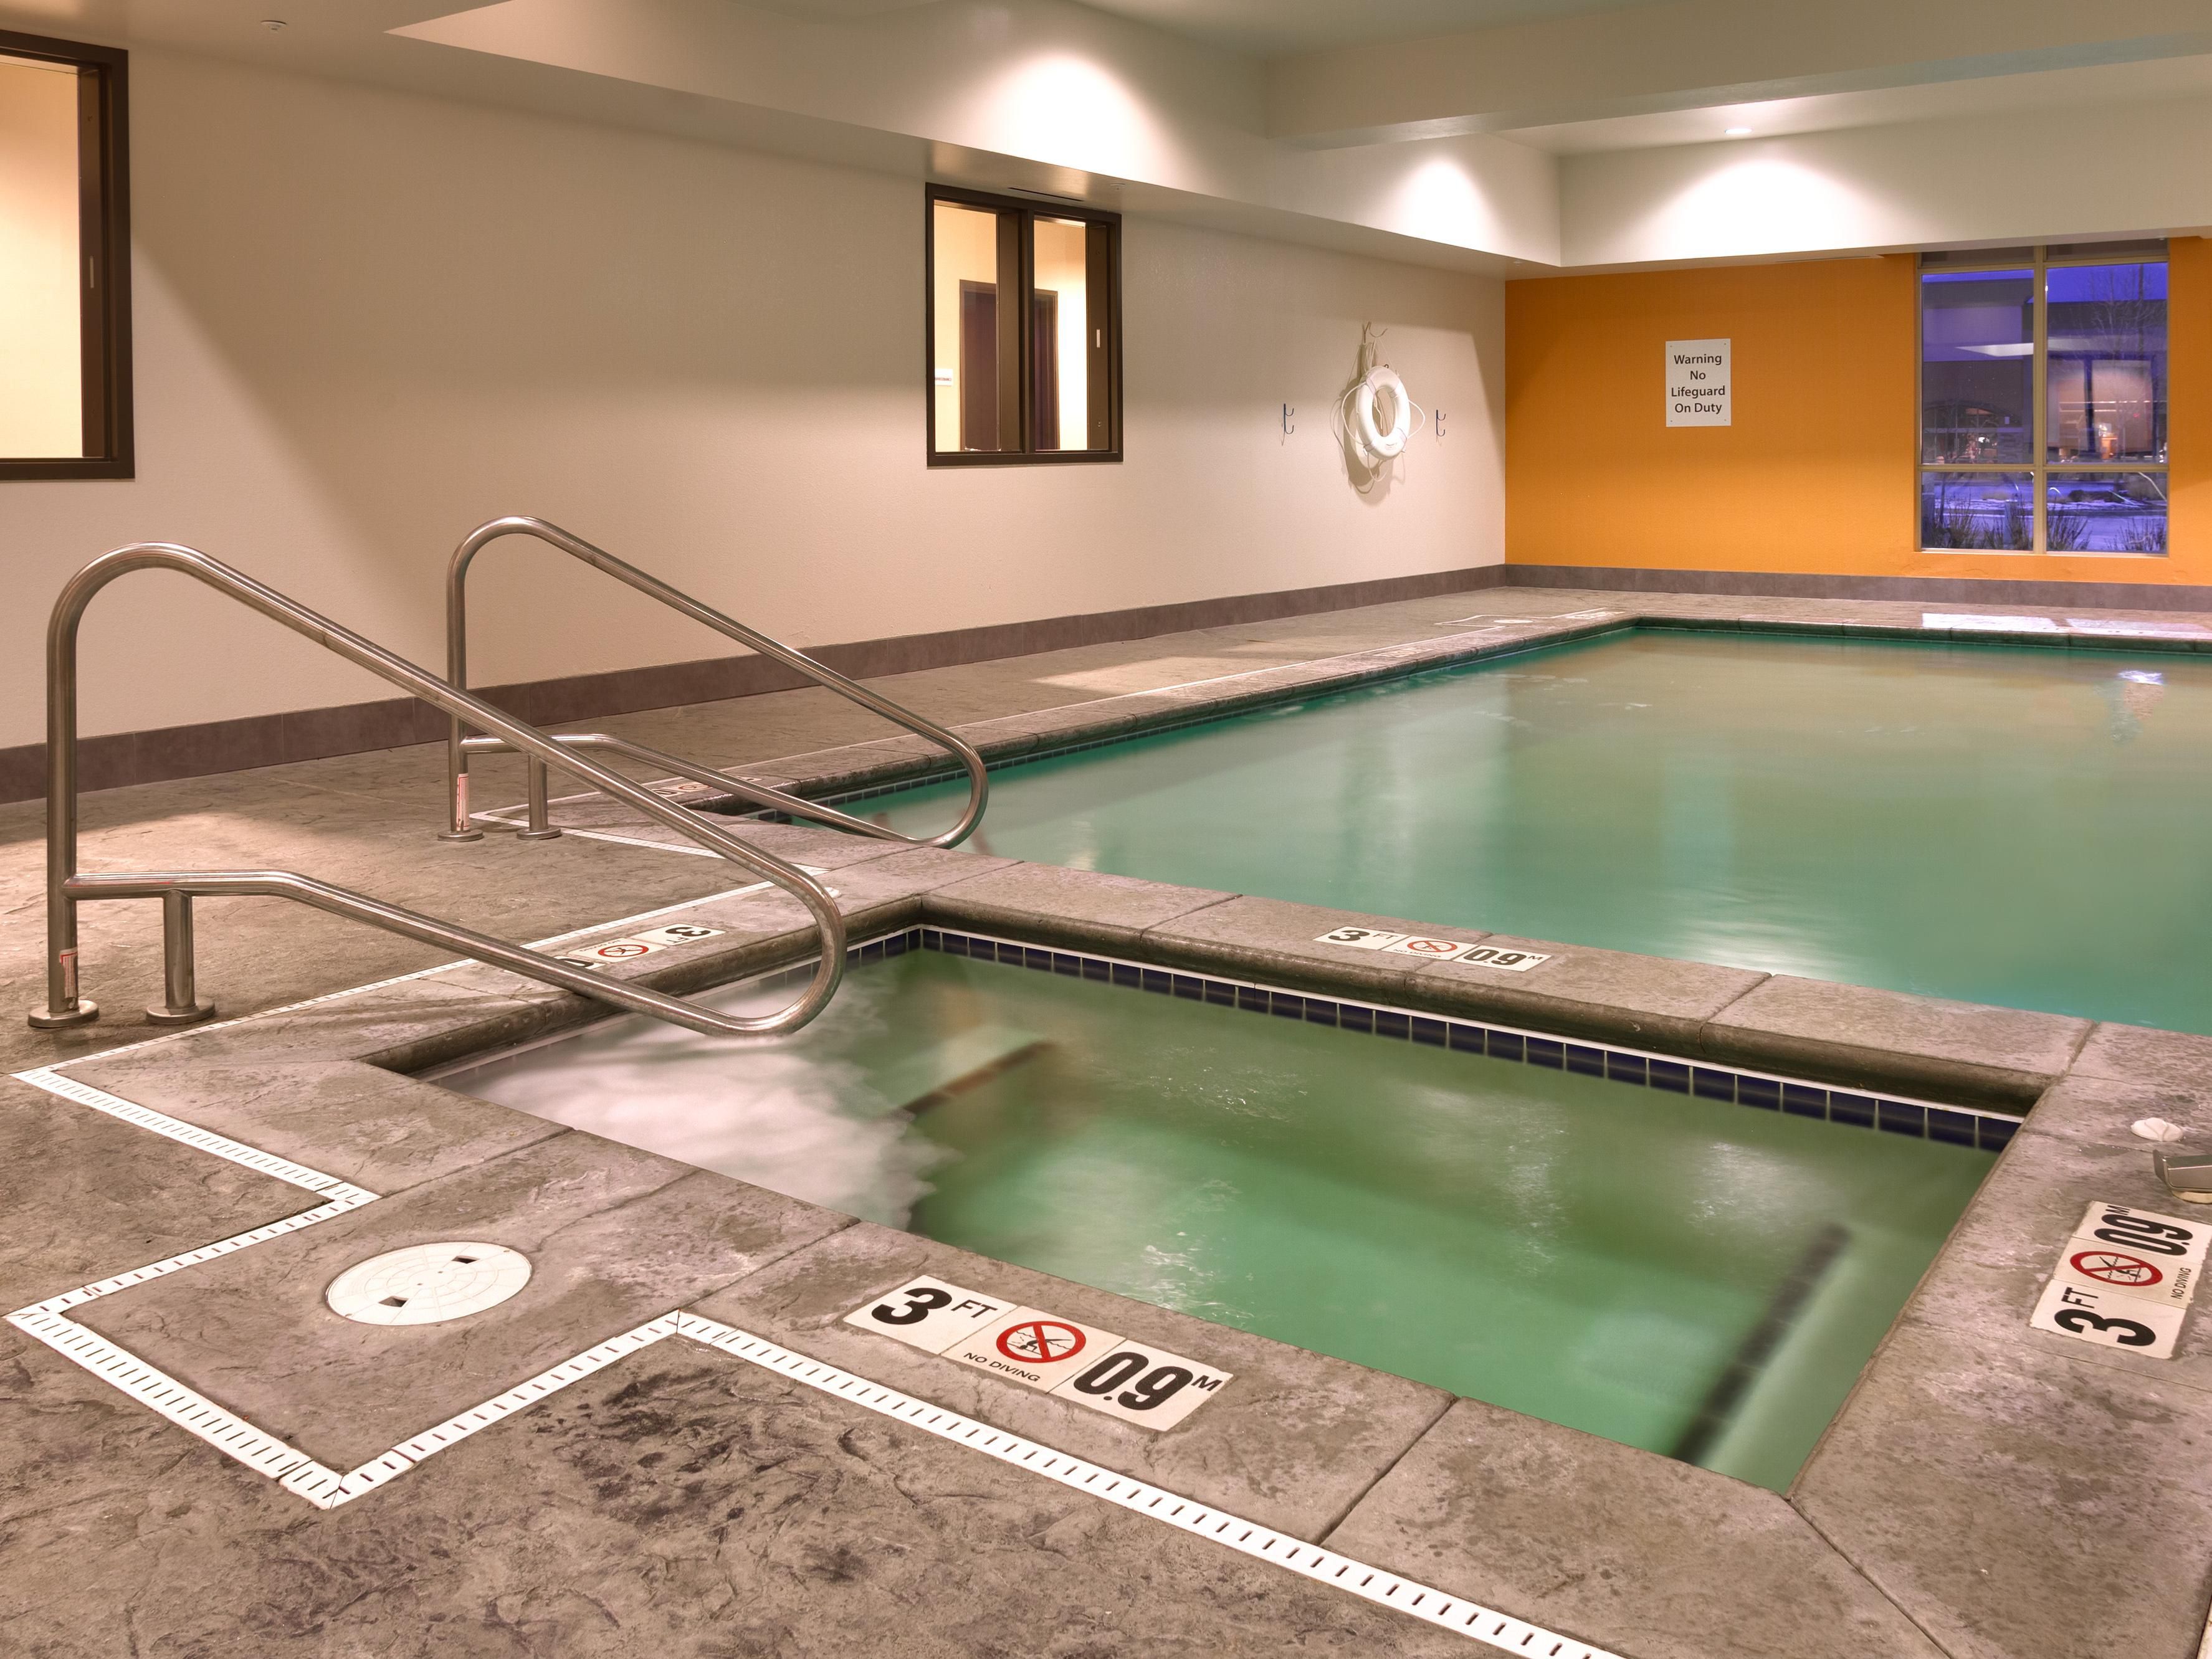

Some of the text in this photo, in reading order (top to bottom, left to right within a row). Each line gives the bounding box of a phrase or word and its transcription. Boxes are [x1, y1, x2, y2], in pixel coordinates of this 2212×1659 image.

[1674, 353, 1722, 366] Warning
[1690, 370, 1706, 380] No
[1671, 385, 1725, 399] Lifeguard
[1674, 402, 1722, 414] On Duty
[665, 926, 712, 937] 3
[1328, 929, 1370, 942] 3
[2170, 1267, 2191, 1300] NO DIVING
[871, 1286, 999, 1325] 3 FT
[2054, 1286, 2157, 1346] 3 FT
[963, 1352, 1041, 1382] NO DIVING
[1073, 1351, 1194, 1411] 0.9
